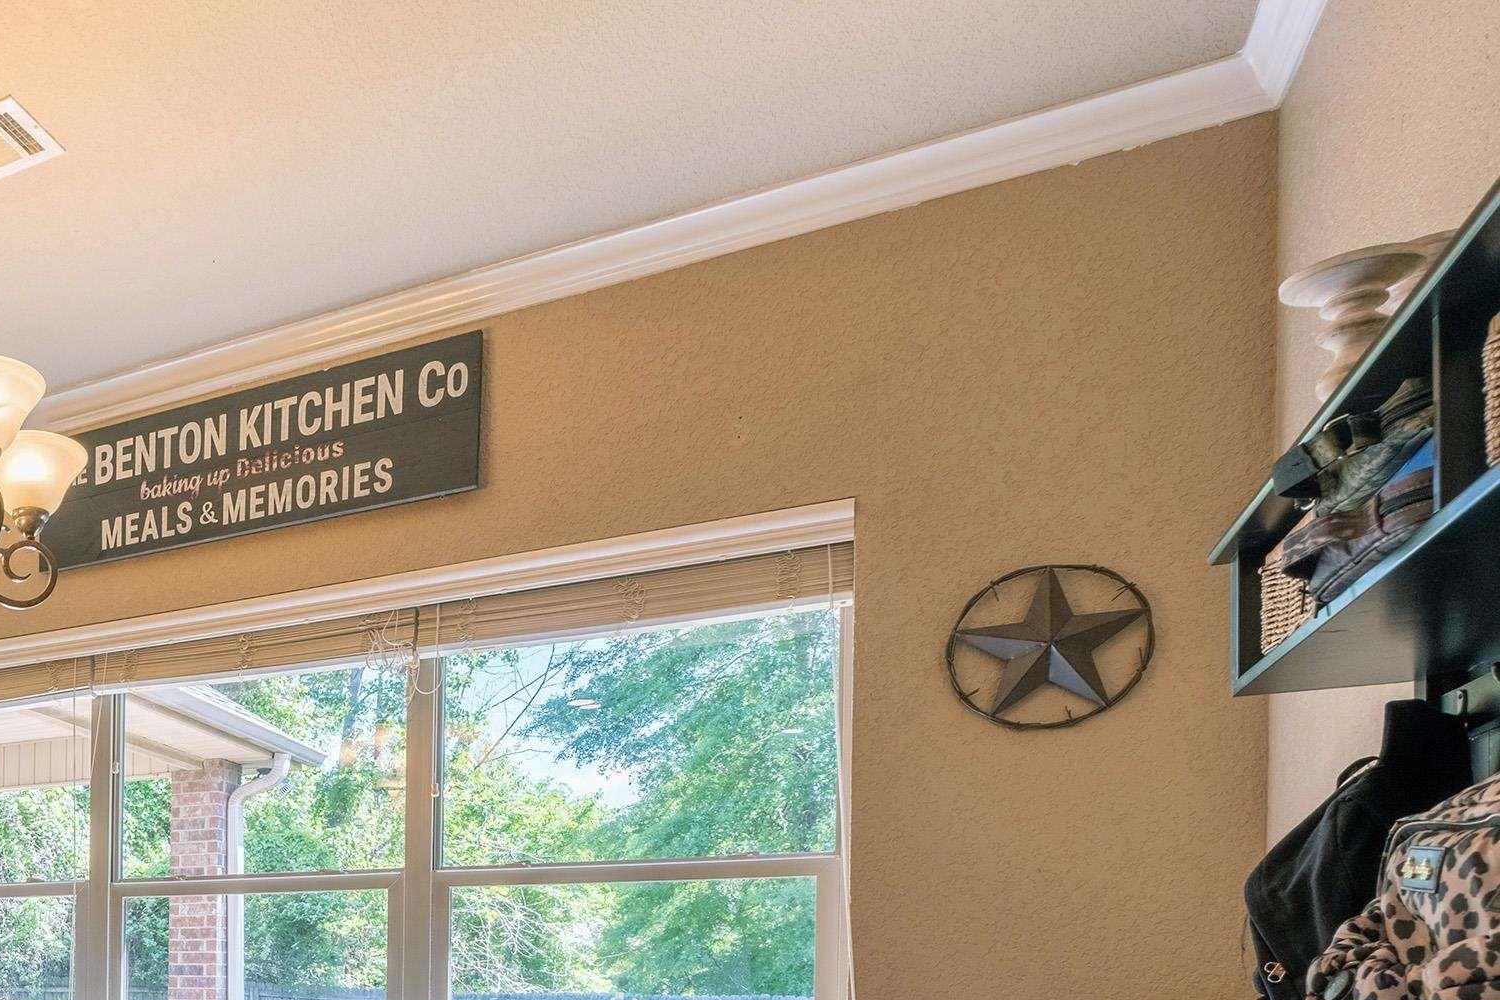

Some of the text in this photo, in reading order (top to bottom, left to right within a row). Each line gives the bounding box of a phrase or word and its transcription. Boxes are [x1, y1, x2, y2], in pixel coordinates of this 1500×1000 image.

[95, 413, 227, 486] BENTON
[239, 369, 404, 451] KITCHEN
[140, 439, 345, 501] baking up Delicious
[101, 457, 394, 550] MEALS & MEMORIES
